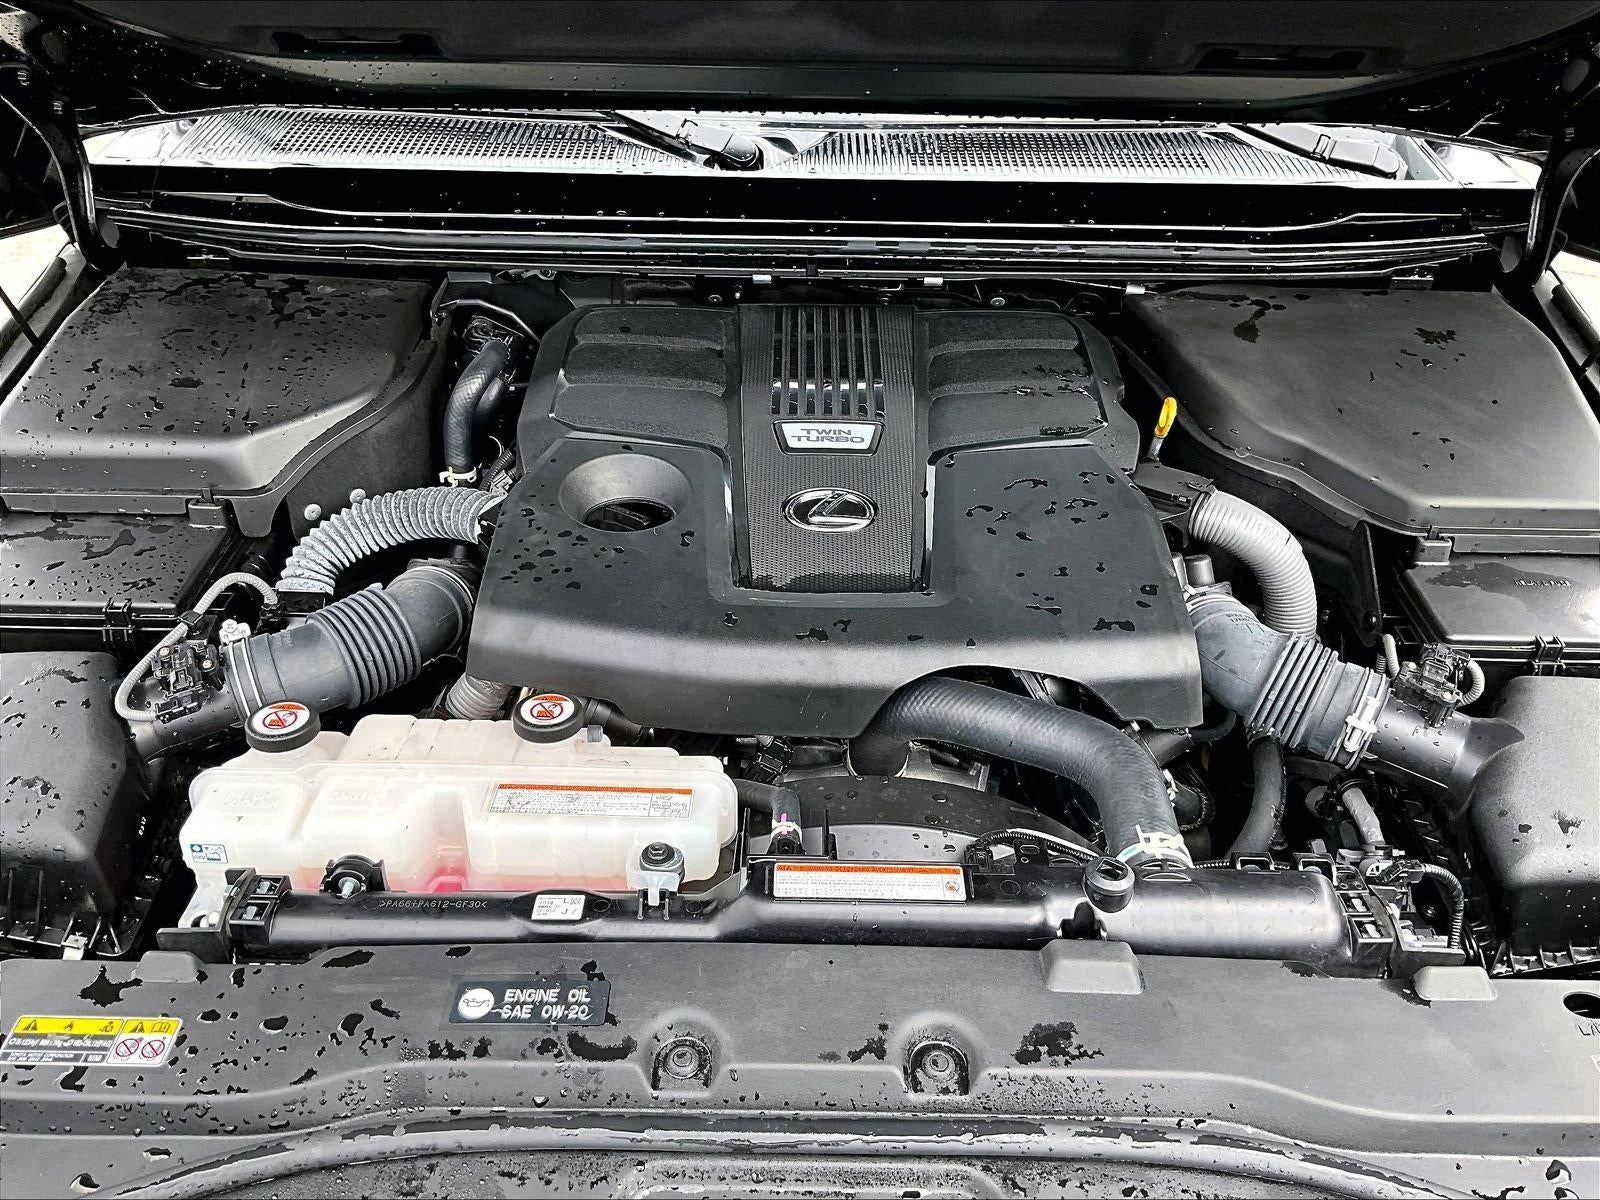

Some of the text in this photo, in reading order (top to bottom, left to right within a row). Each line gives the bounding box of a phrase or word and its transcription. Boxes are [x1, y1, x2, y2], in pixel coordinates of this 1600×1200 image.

[800, 428, 852, 436] TWIN
[791, 435, 865, 444] TURBO
[503, 988, 592, 1003] ENGINE OIL
[500, 1004, 590, 1021] SAE 0W-20
